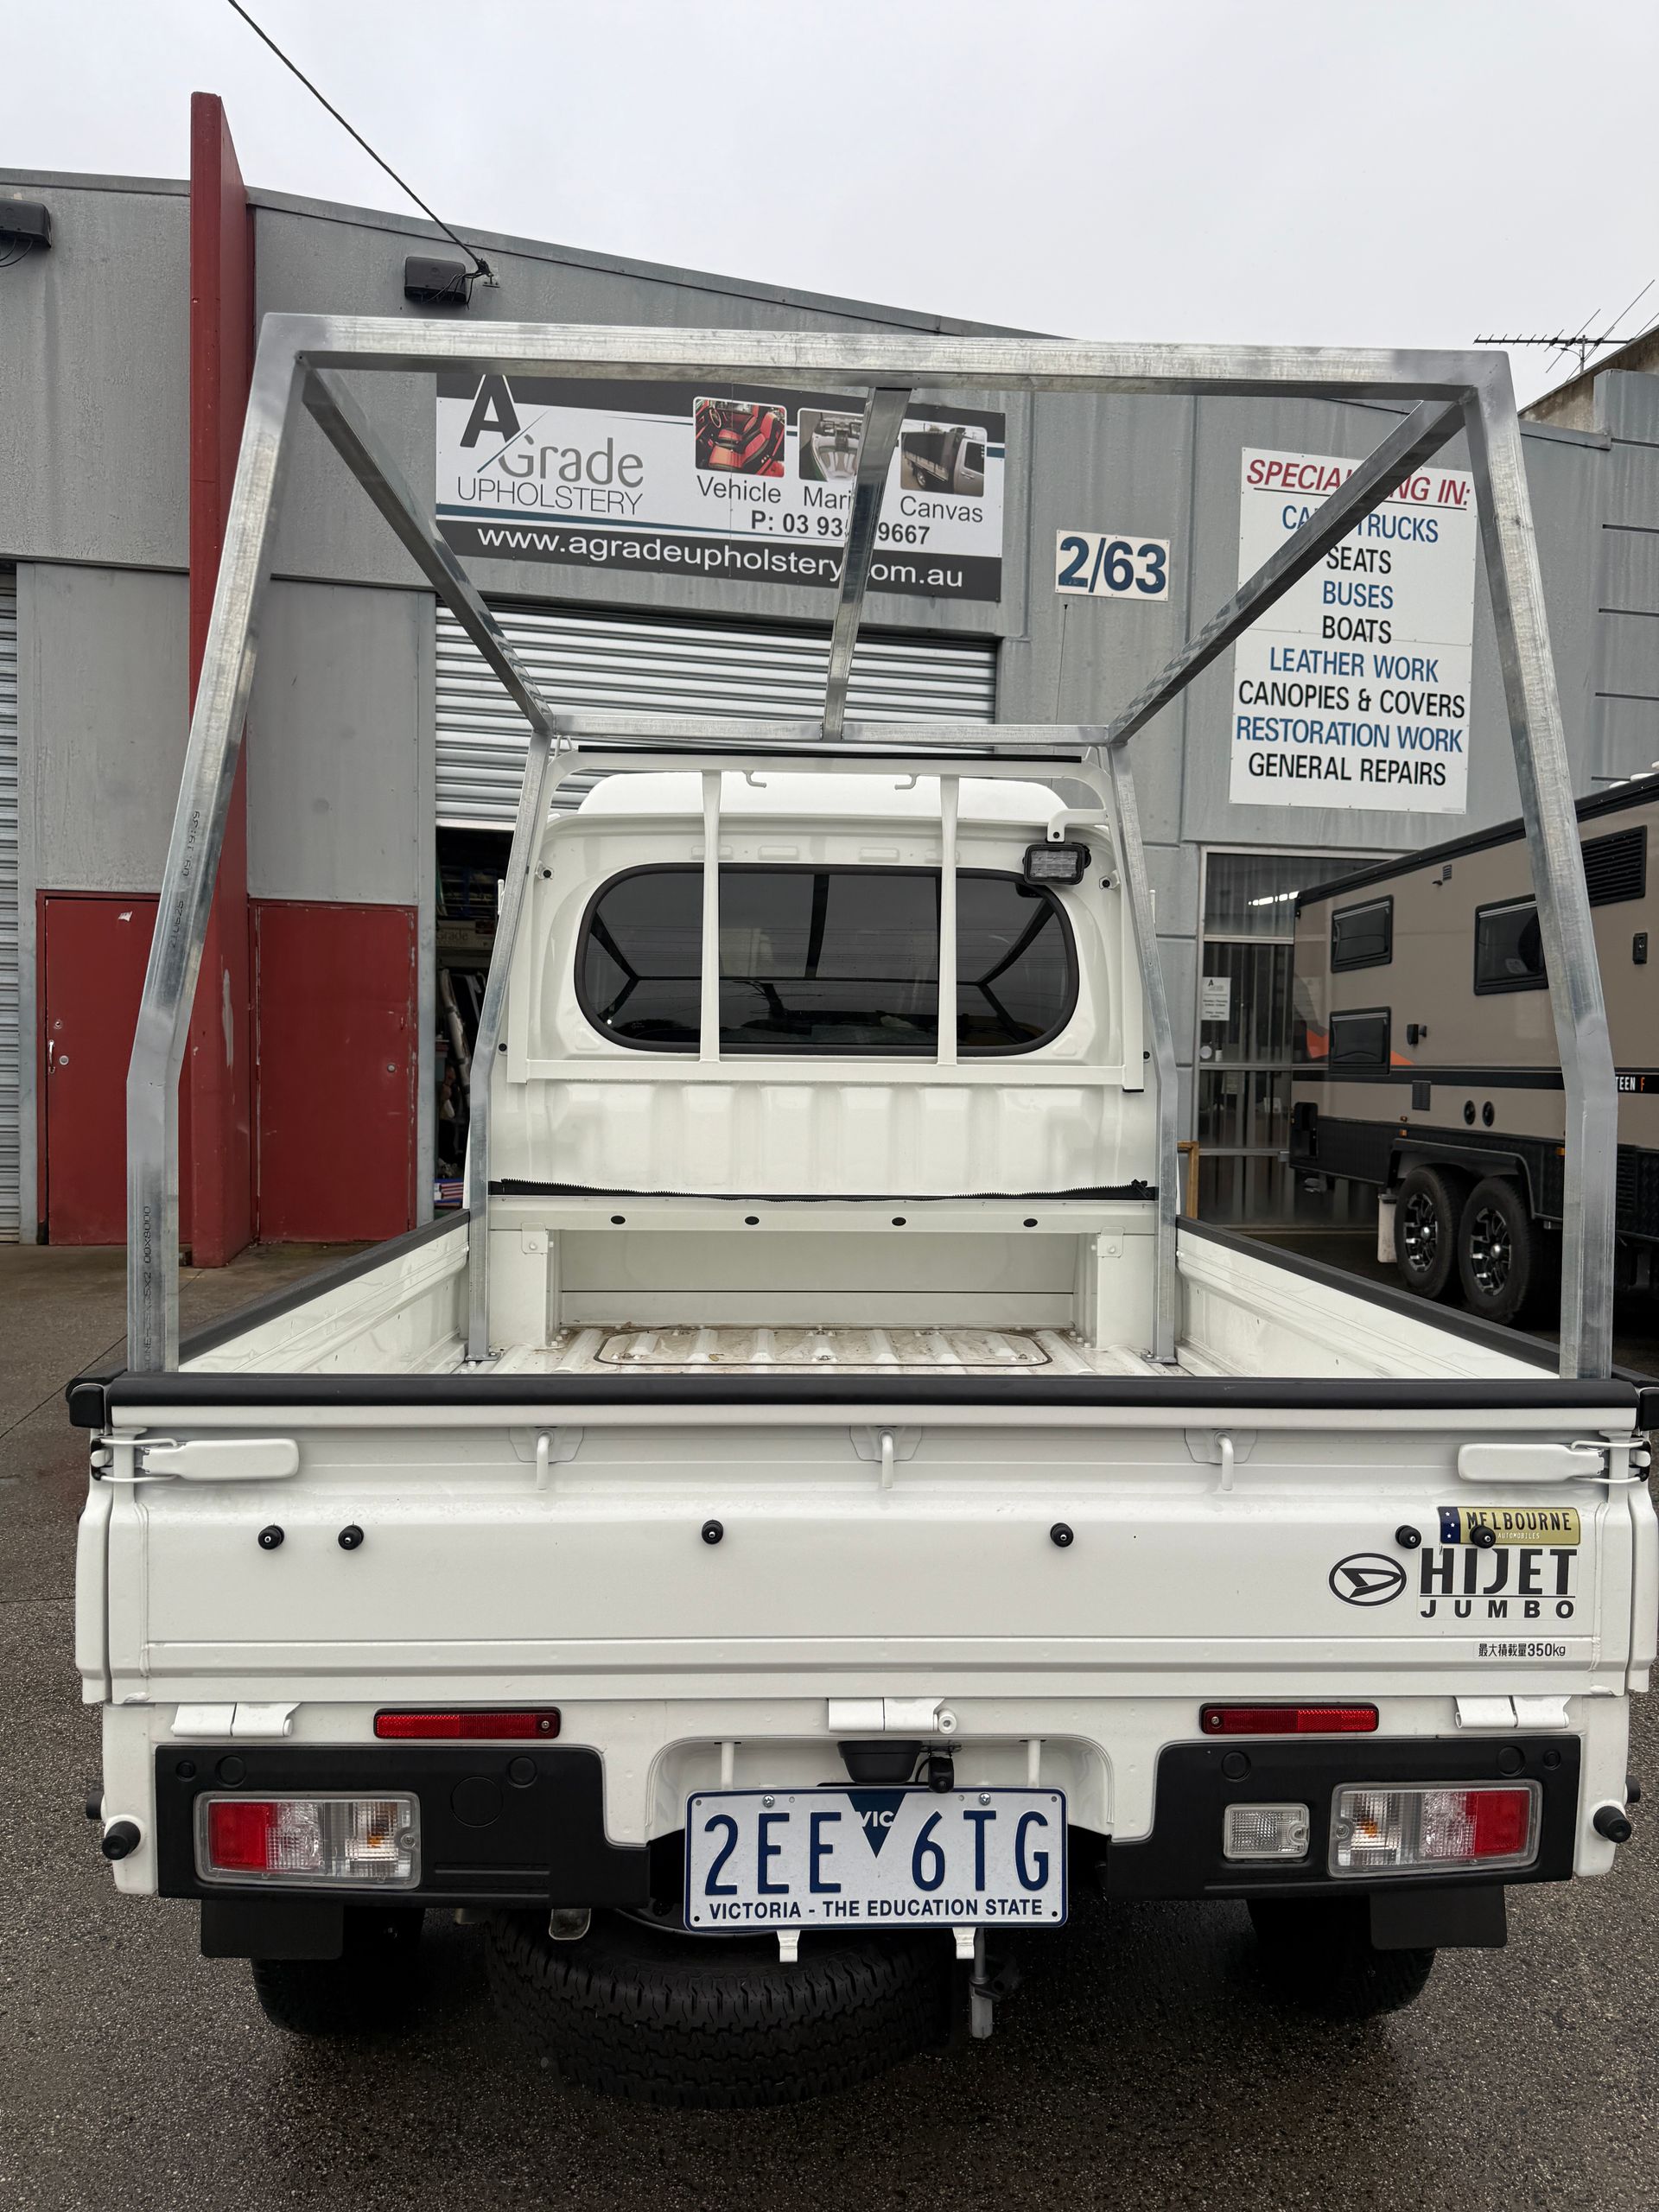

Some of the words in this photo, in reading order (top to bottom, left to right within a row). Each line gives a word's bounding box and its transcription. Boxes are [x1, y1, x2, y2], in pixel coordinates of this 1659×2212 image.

[460, 375, 521, 448] A
[498, 434, 644, 488] Grade
[457, 476, 644, 516] UPHOLSTERY
[696, 475, 782, 503] Vehicle
[804, 486, 852, 510] Mari
[1246, 459, 1431, 501] SPECIANG
[1437, 478, 1471, 505] IN:
[899, 495, 983, 523] Canvas
[751, 511, 773, 531] P:
[782, 513, 809, 534] 03
[817, 517, 843, 537] 93
[877, 522, 931, 545] 9667
[477, 528, 964, 587] www.agradeupholsteryom.au
[1058, 536, 1166, 594] 2/63
[1326, 545, 1392, 574] SEATS
[1322, 580, 1394, 610] BUSES
[1322, 615, 1392, 644] BOATS
[1269, 646, 1364, 678] LEATHER
[1373, 654, 1440, 683] WORK
[1237, 679, 1349, 711] CANOPIES
[1357, 690, 1371, 712] &
[1380, 690, 1465, 719] COVERS
[1236, 715, 1389, 749] RESTORATION
[1397, 726, 1463, 753] WORK
[1249, 752, 1351, 781] GENERAL
[1360, 758, 1446, 786] REPAIRS
[1465, 1511, 1572, 1531] MELBOURNE
[1420, 1548, 1578, 1595] HIJET
[1420, 1599, 1574, 1618] JUMBO
[1478, 1643, 1566, 1657] 最大積載量350kg
[858, 1810, 894, 1827] VIC
[709, 1901, 802, 1920] VICTORIA
[823, 1900, 860, 1918] THE
[868, 1898, 978, 1917] EDUCATION
[985, 1898, 1043, 1916] STATE
